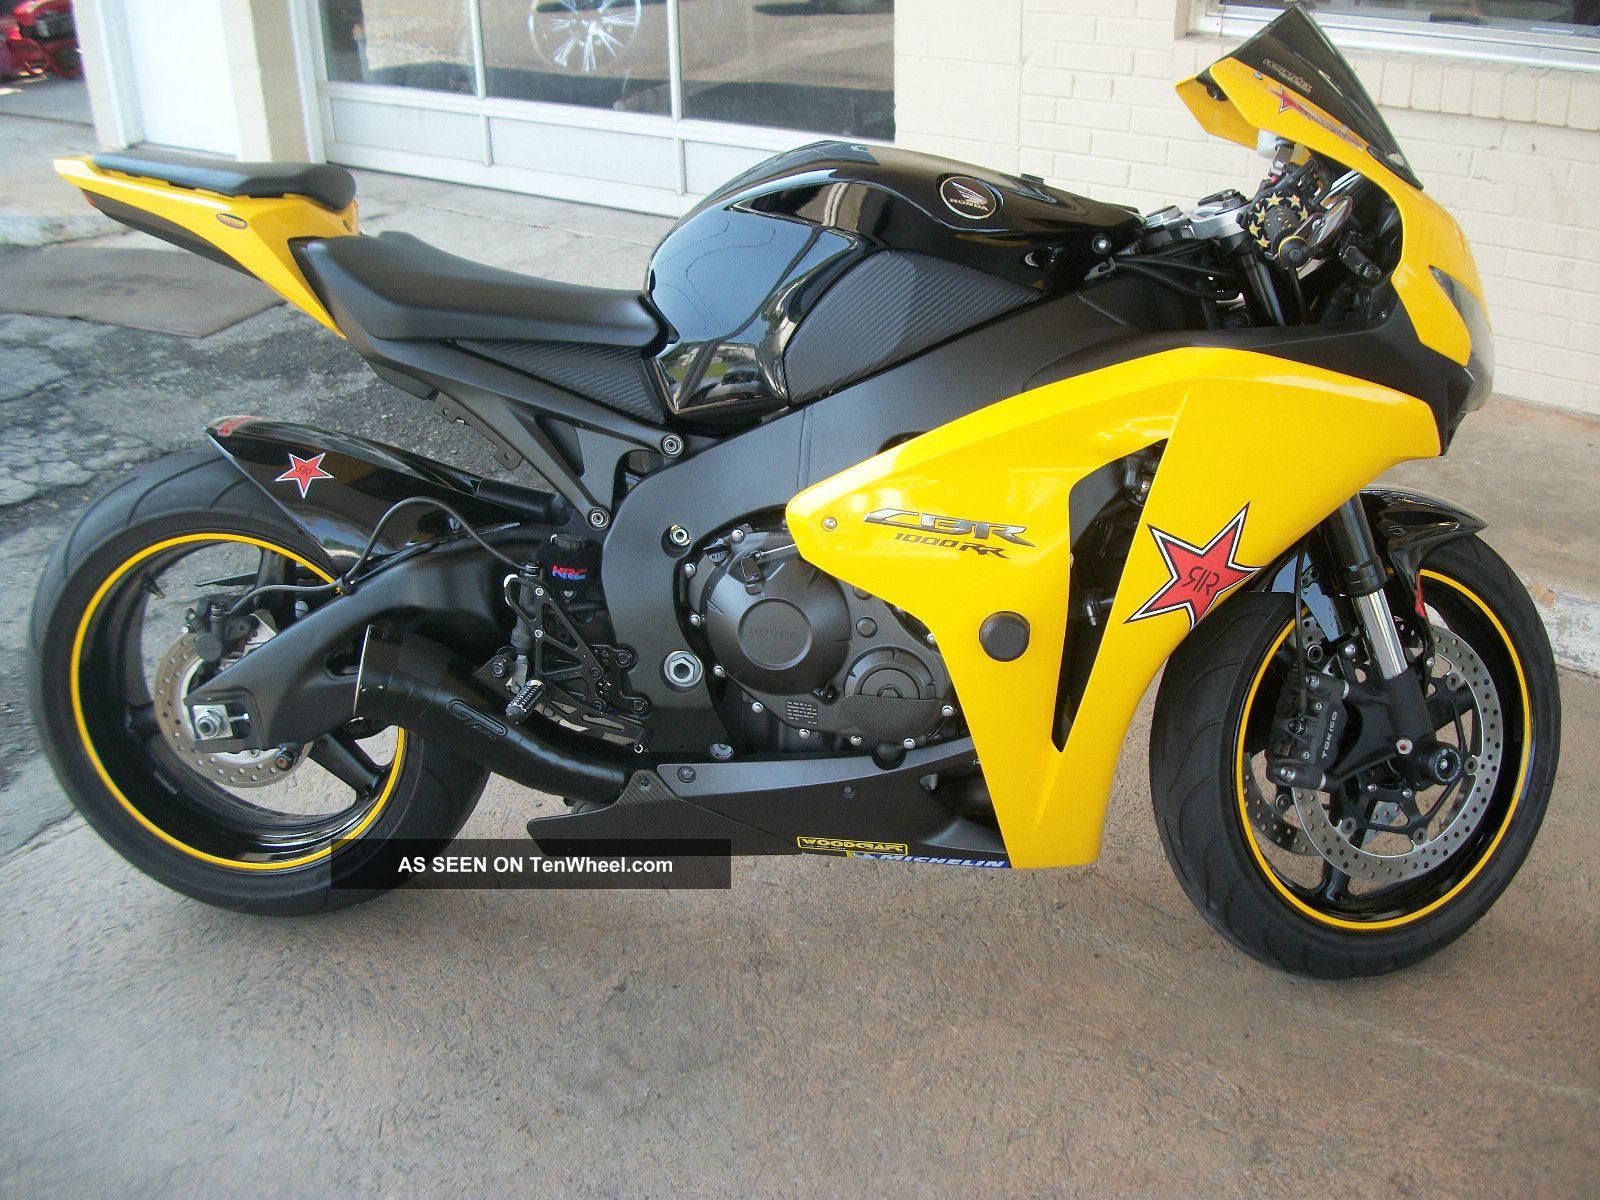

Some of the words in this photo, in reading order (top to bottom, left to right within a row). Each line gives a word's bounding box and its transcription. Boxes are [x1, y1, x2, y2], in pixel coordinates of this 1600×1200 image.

[949, 198, 989, 211] HONDA
[863, 508, 1036, 548] CBR
[552, 565, 588, 581] HRC
[1321, 711, 1338, 759] TOKICO
[801, 838, 904, 853] WOODCRAFT
[878, 854, 1005, 868] MICHELIN
